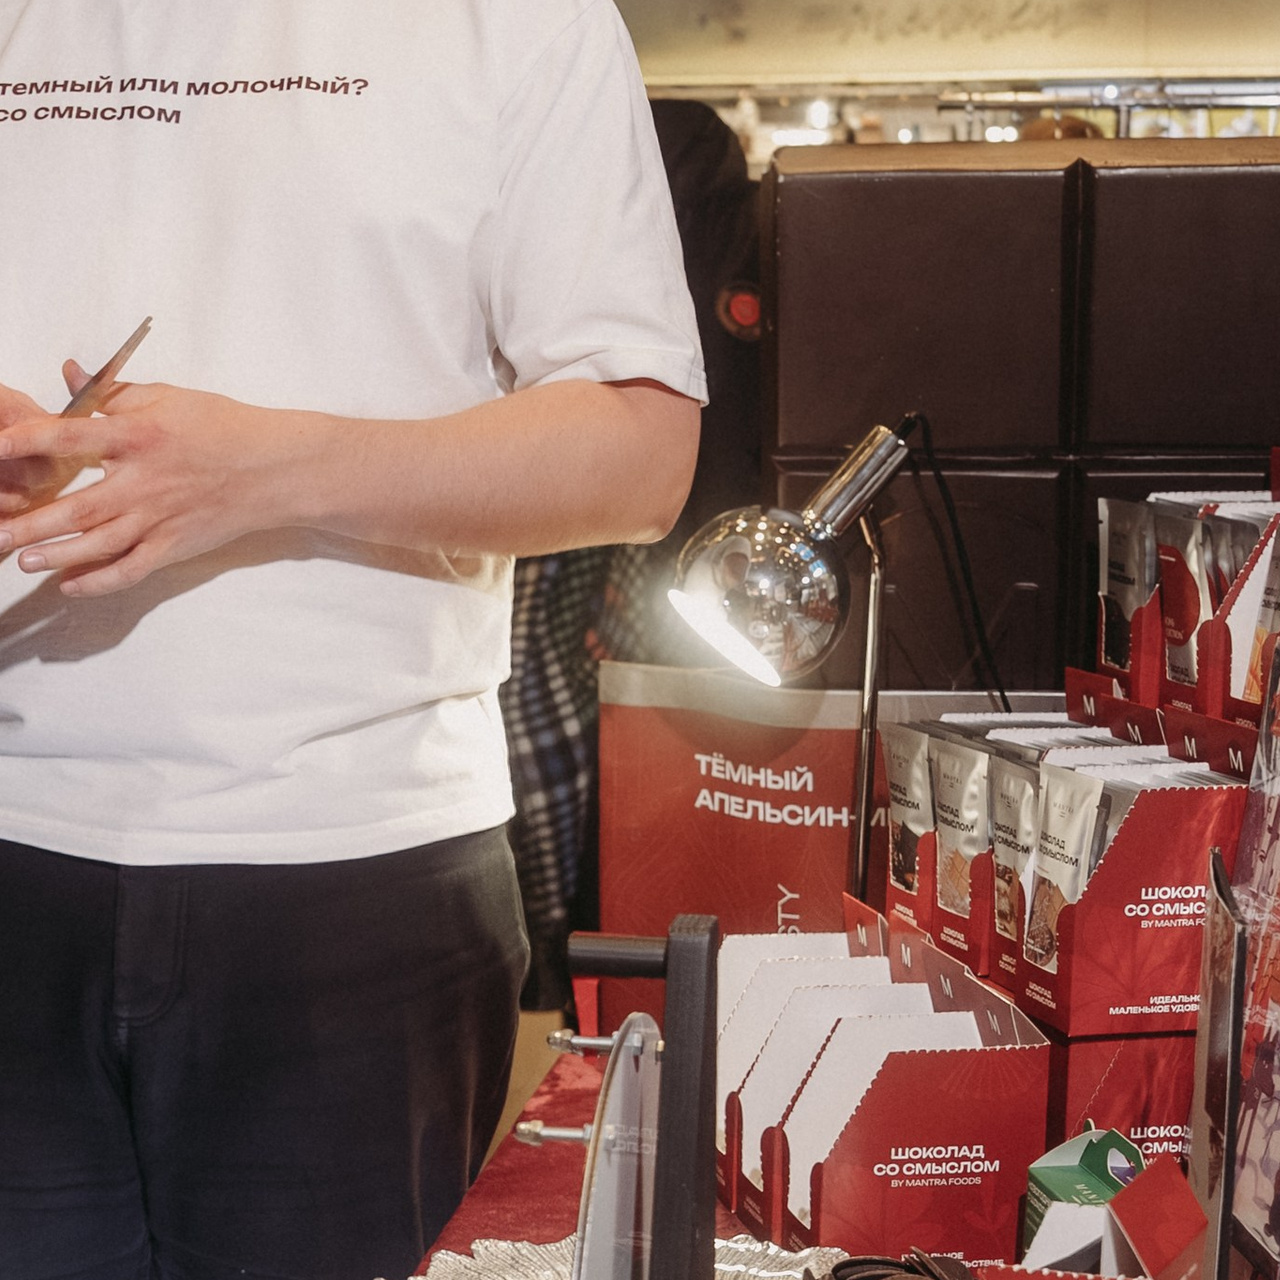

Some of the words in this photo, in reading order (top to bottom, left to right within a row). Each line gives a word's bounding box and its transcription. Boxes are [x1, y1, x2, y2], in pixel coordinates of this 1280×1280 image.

[694, 751, 814, 792] ТЁМНЫЙ
[1141, 885, 1208, 900] ШОКОЛ
[1124, 904, 1150, 917] СО
[1152, 901, 1207, 916] СМЫС
[1141, 920, 1154, 929] BY
[1154, 918, 1194, 928] MANTRA
[1109, 1005, 1170, 1016] МАЛЕНЬКОЕ
[1171, 1004, 1201, 1014] УДОВ
[891, 1145, 985, 1160] ШОКОЛАД
[873, 1163, 900, 1176] СО
[902, 1160, 1000, 1175] СМЫСЛОМ
[891, 1179, 905, 1188] BY
[905, 1178, 947, 1187] MANTRA
[948, 1177, 982, 1186] FOODS
